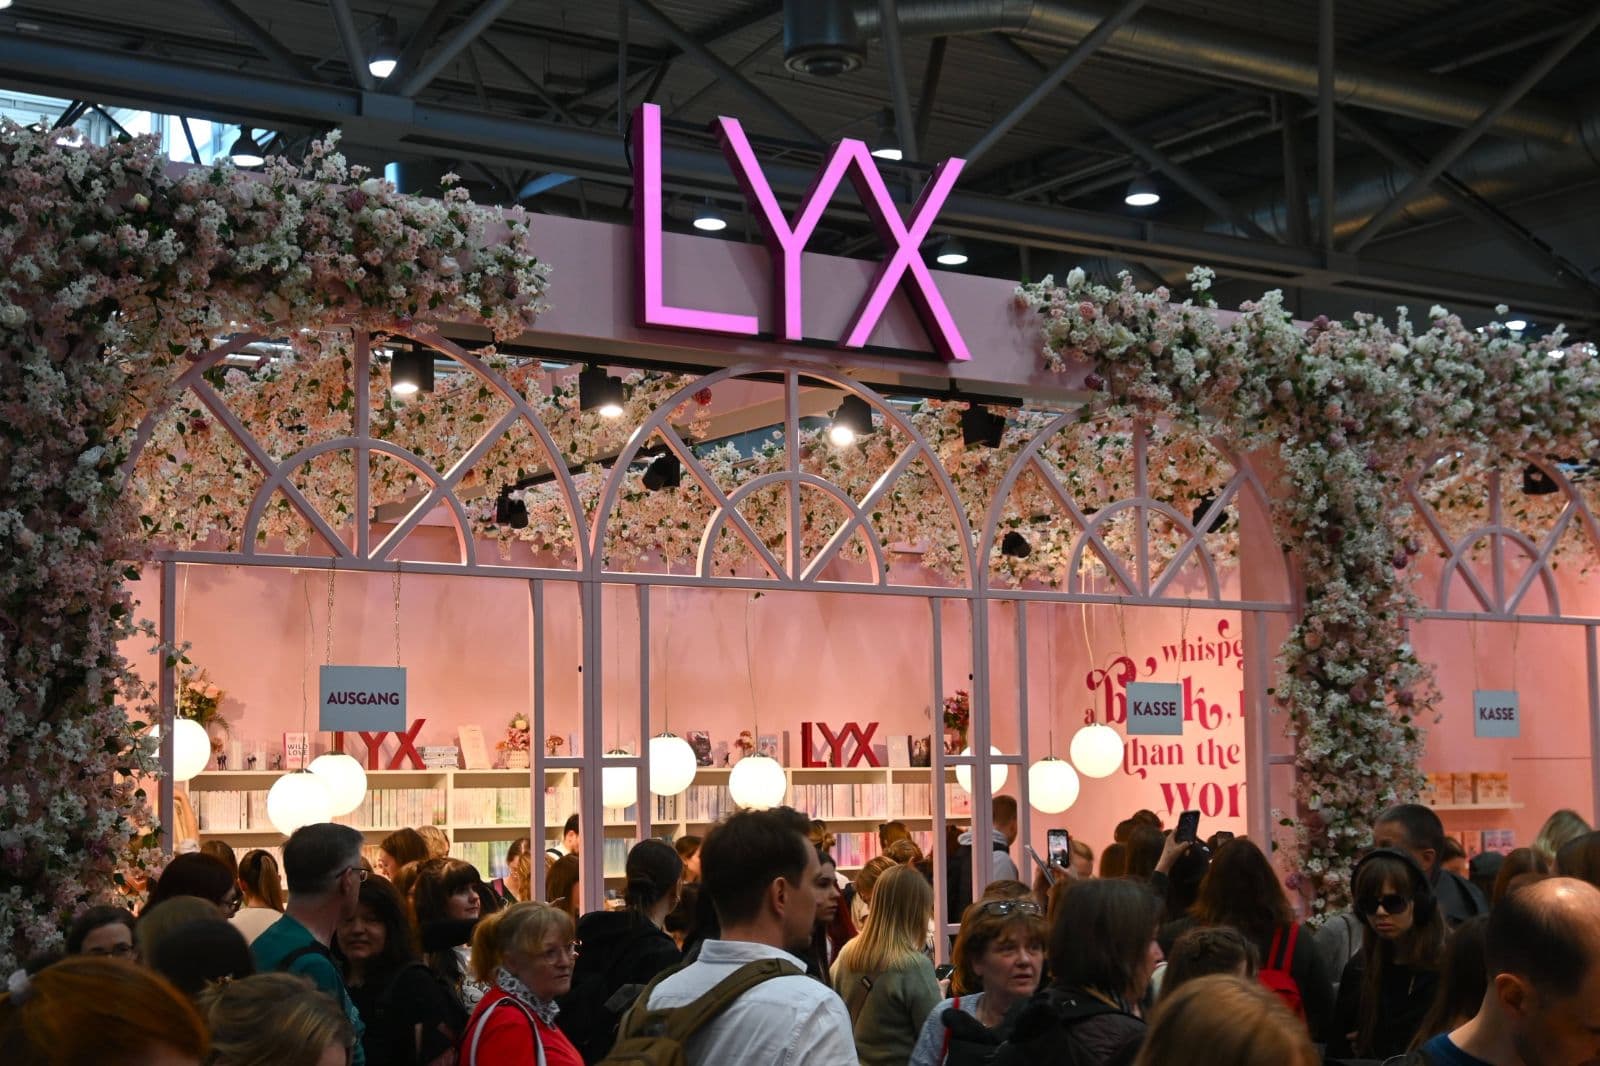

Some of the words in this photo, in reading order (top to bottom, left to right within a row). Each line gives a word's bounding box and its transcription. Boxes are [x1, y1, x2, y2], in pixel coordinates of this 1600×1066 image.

[633, 102, 973, 362] LYX
[326, 691, 400, 706] AUSGANG
[1133, 701, 1177, 716] KASSE
[1479, 707, 1515, 721] KASSE
[801, 721, 881, 768] LYX
[1123, 738, 1184, 779] than
[1197, 738, 1240, 769] the
